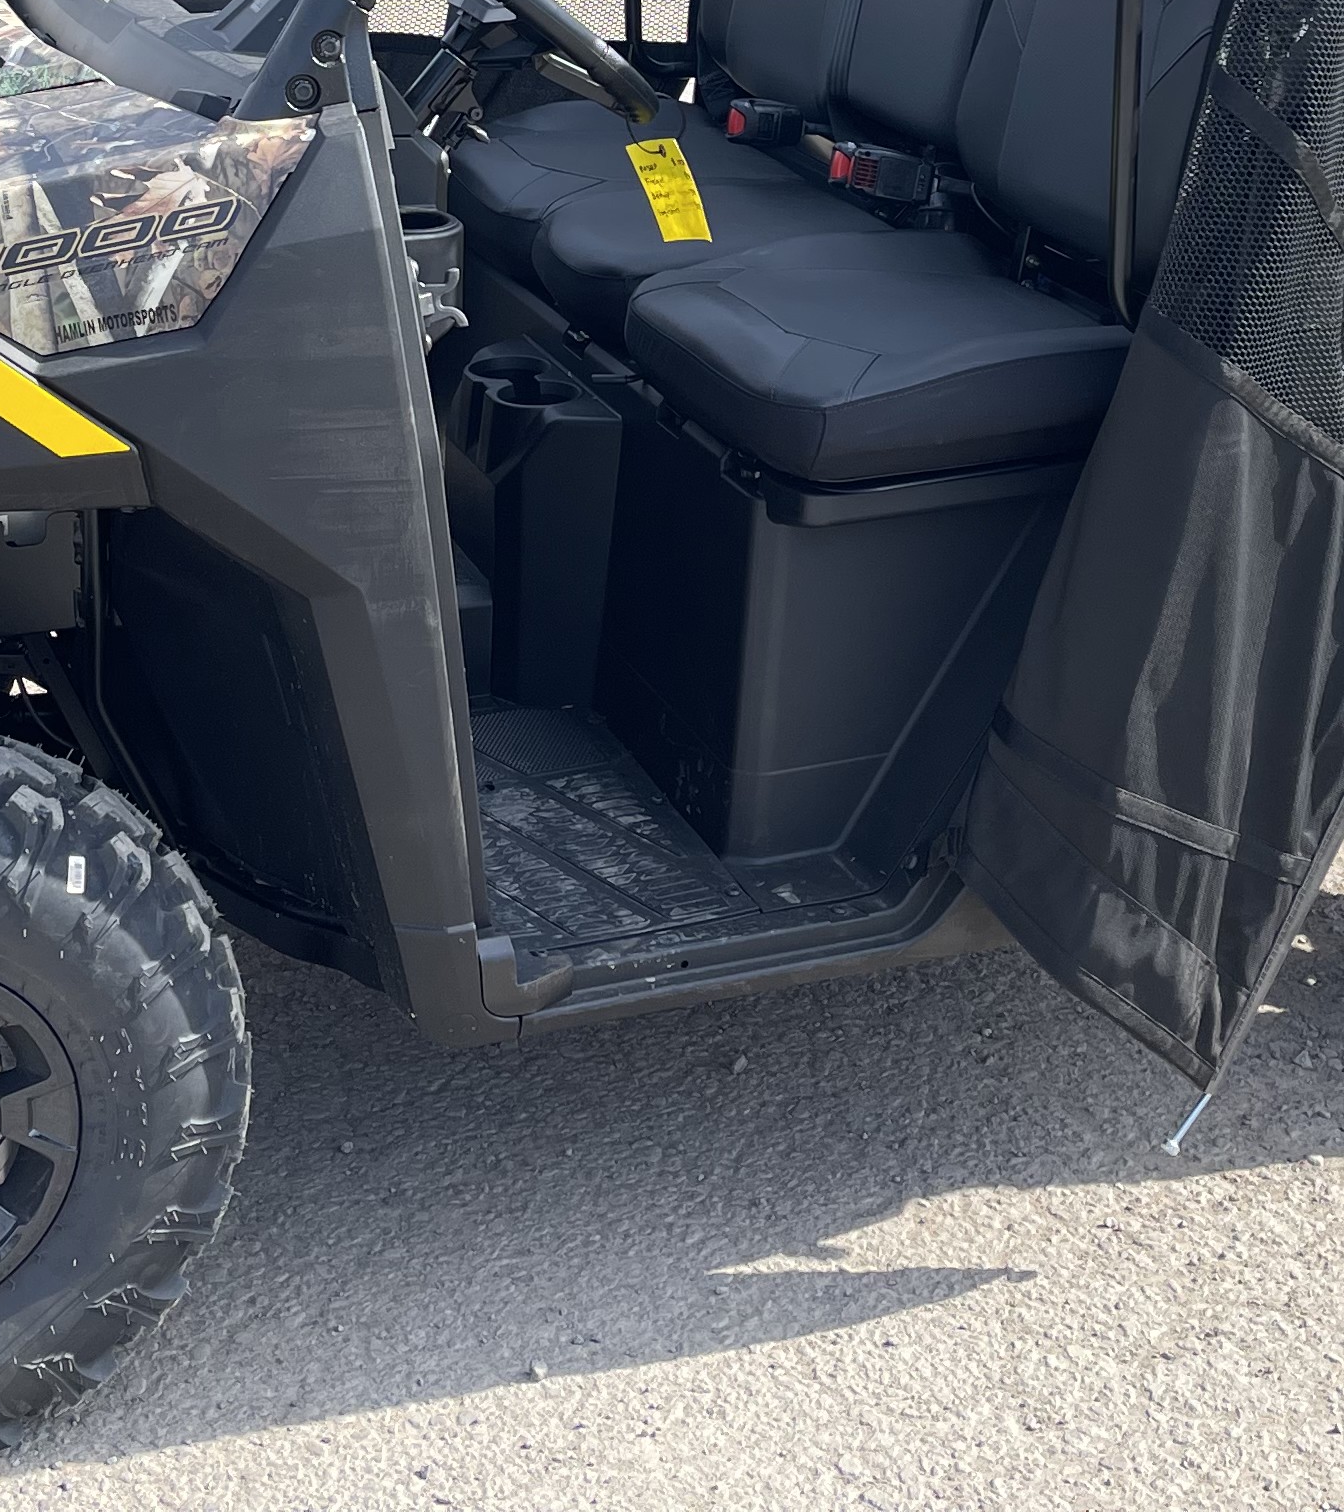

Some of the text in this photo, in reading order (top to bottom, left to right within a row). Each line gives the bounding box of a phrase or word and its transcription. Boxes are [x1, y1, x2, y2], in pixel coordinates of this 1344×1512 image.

[60, 246, 179, 280] OVERHEAD
[182, 238, 229, 255] CAM
[55, 303, 178, 345] HAMLIN MOTORSPORTS
